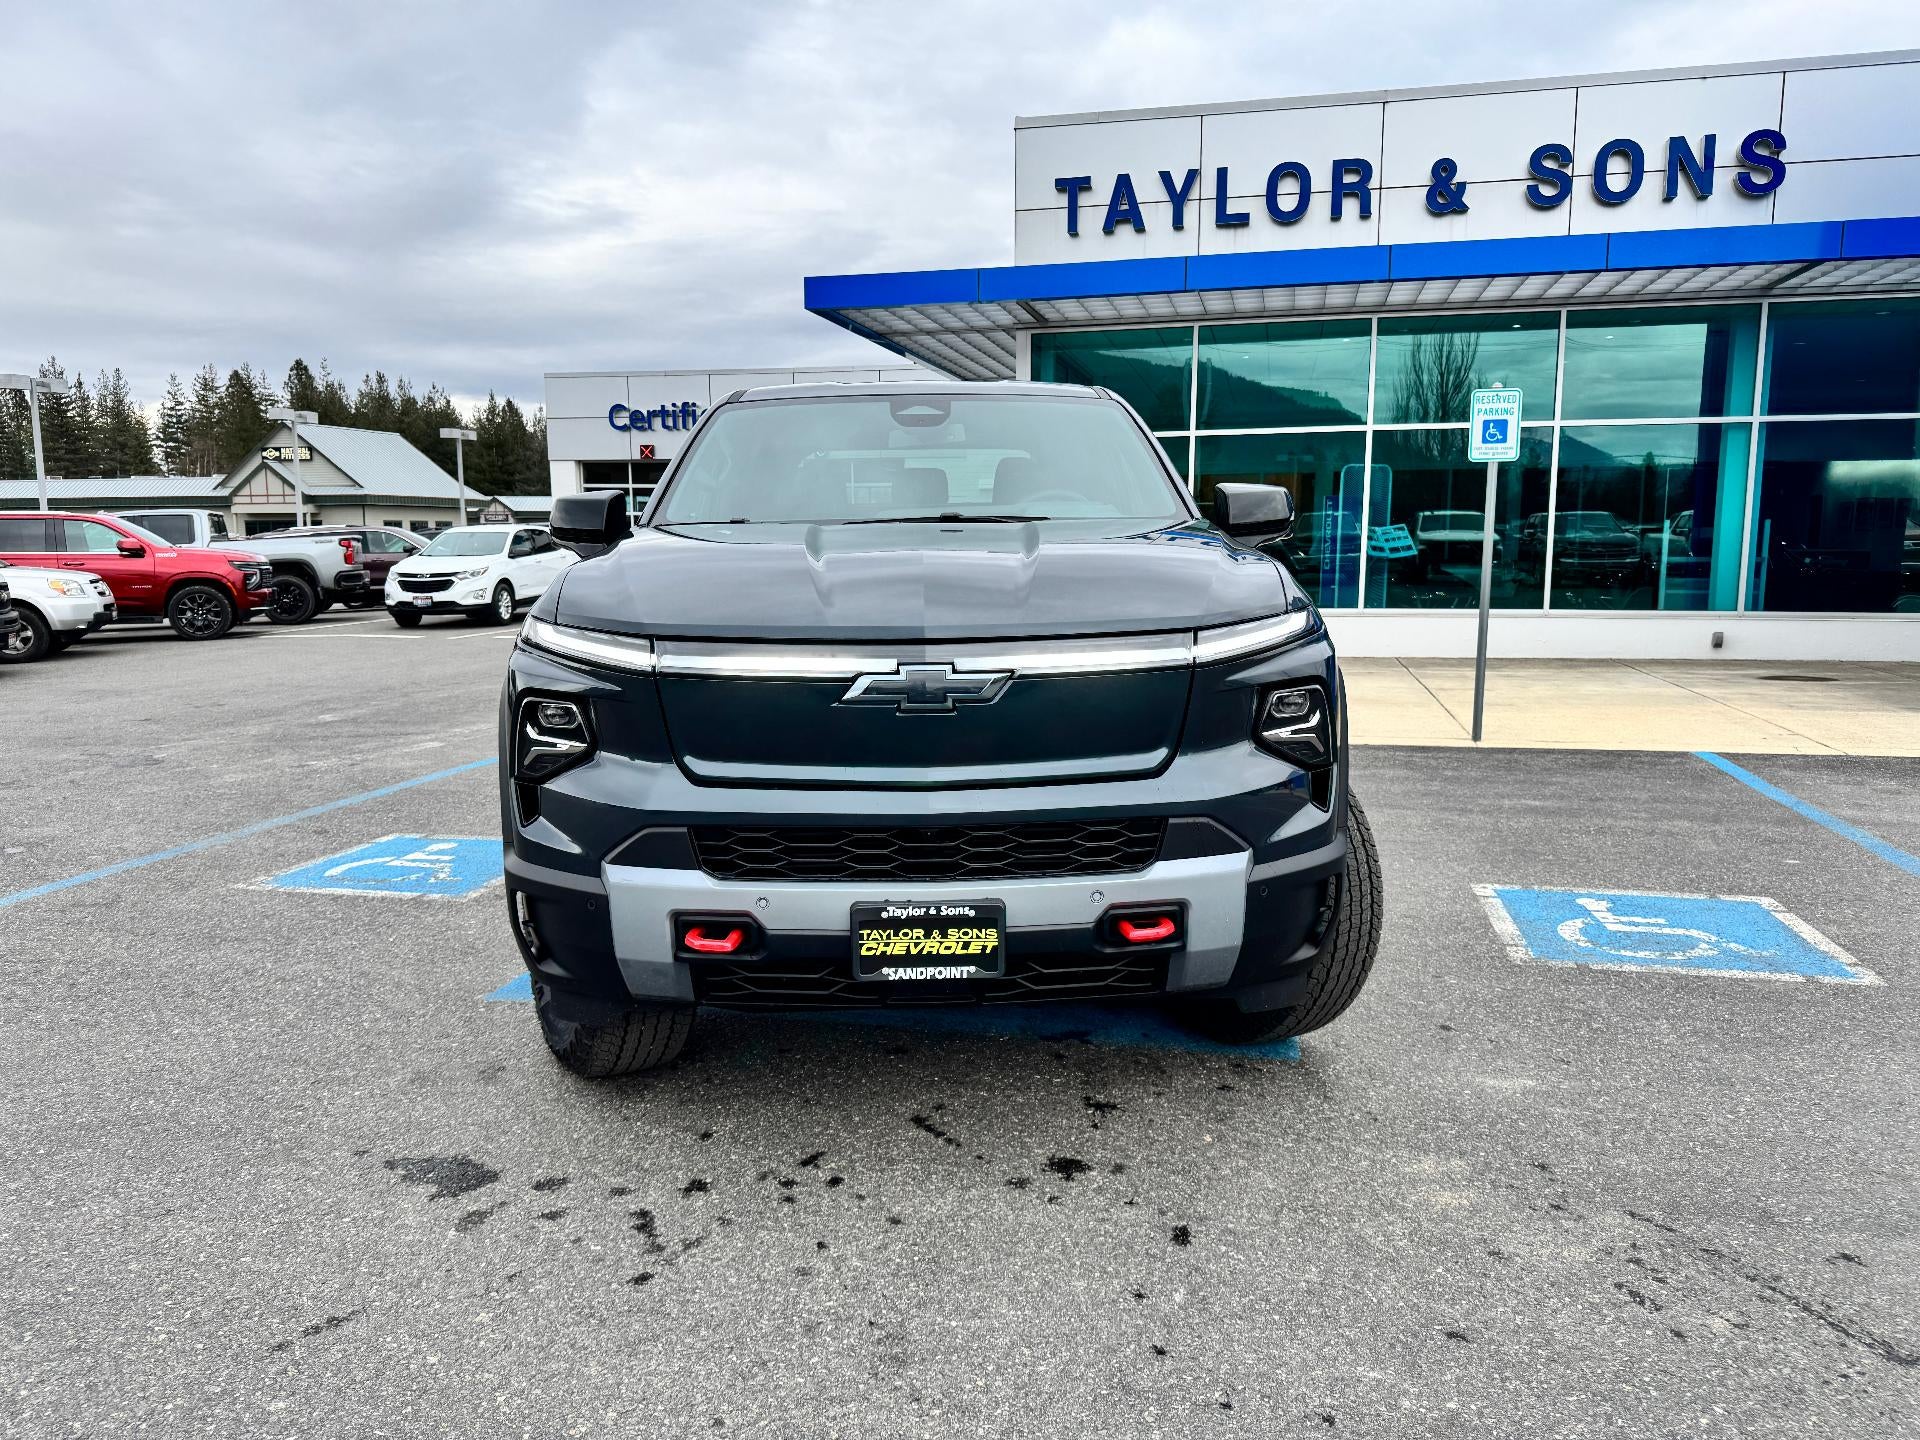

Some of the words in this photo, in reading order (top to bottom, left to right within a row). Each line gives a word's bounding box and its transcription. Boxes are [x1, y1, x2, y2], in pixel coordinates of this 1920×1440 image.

[1055, 157, 1374, 236] TAYLOR
[1425, 157, 1469, 215] &
[1526, 129, 1788, 208] SONS
[1475, 394, 1517, 405] RESERVED
[608, 401, 709, 432] Certifi
[1477, 407, 1515, 416] PARKING
[1323, 499, 1334, 570] CHEVROLET
[886, 906, 926, 919] Taylor
[929, 906, 937, 915] &
[940, 905, 970, 915] Sons
[859, 929, 925, 941] TAYLOR
[930, 929, 942, 941] &
[947, 928, 998, 940] SONS
[860, 941, 998, 956] CHEVROLET
[888, 966, 970, 980] SANDPOINT
